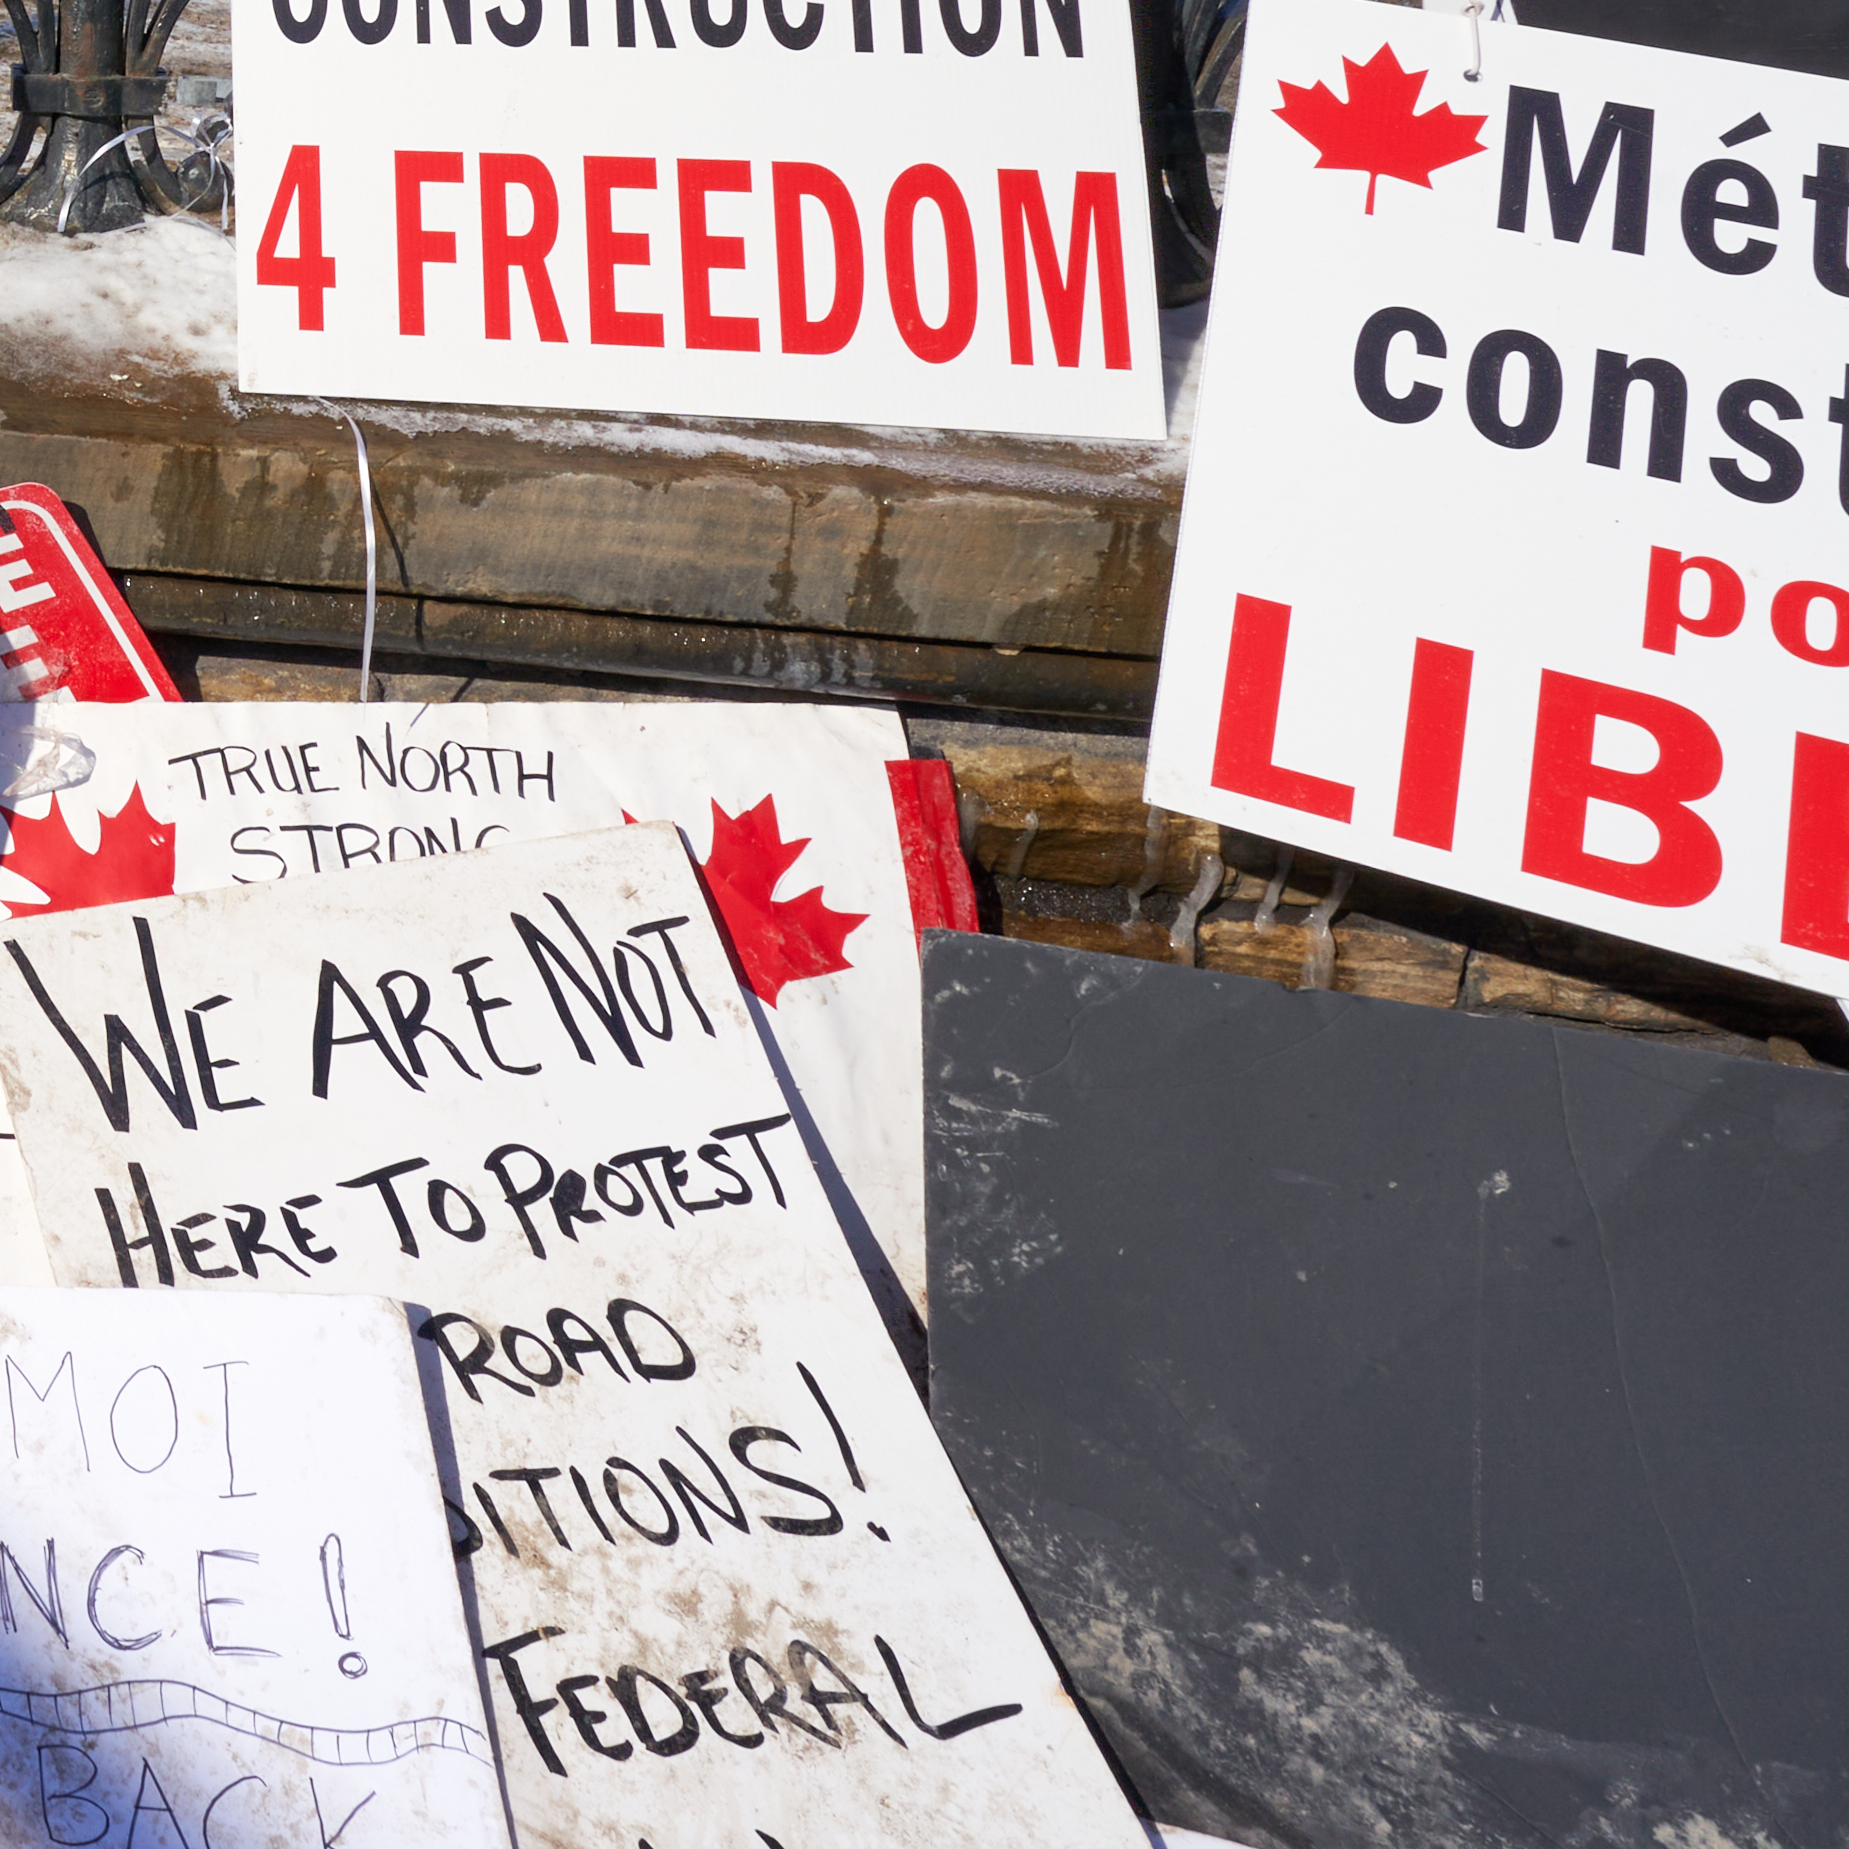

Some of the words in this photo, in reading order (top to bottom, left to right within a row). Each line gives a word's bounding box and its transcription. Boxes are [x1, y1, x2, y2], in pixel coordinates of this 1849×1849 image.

[256, 144, 336, 332] 4
[394, 149, 1132, 371] FREEDOM
[168, 741, 332, 801] TRUE
[357, 722, 555, 803] NORTH
[3, 916, 264, 1134] WE
[312, 956, 544, 1101] ARE
[510, 891, 716, 1068] NOT
[94, 1162, 337, 1288] HERE
[336, 1155, 486, 1259] TO
[484, 1113, 791, 1260] PROTEST
[483, 1626, 1023, 1778] FEDERAL
